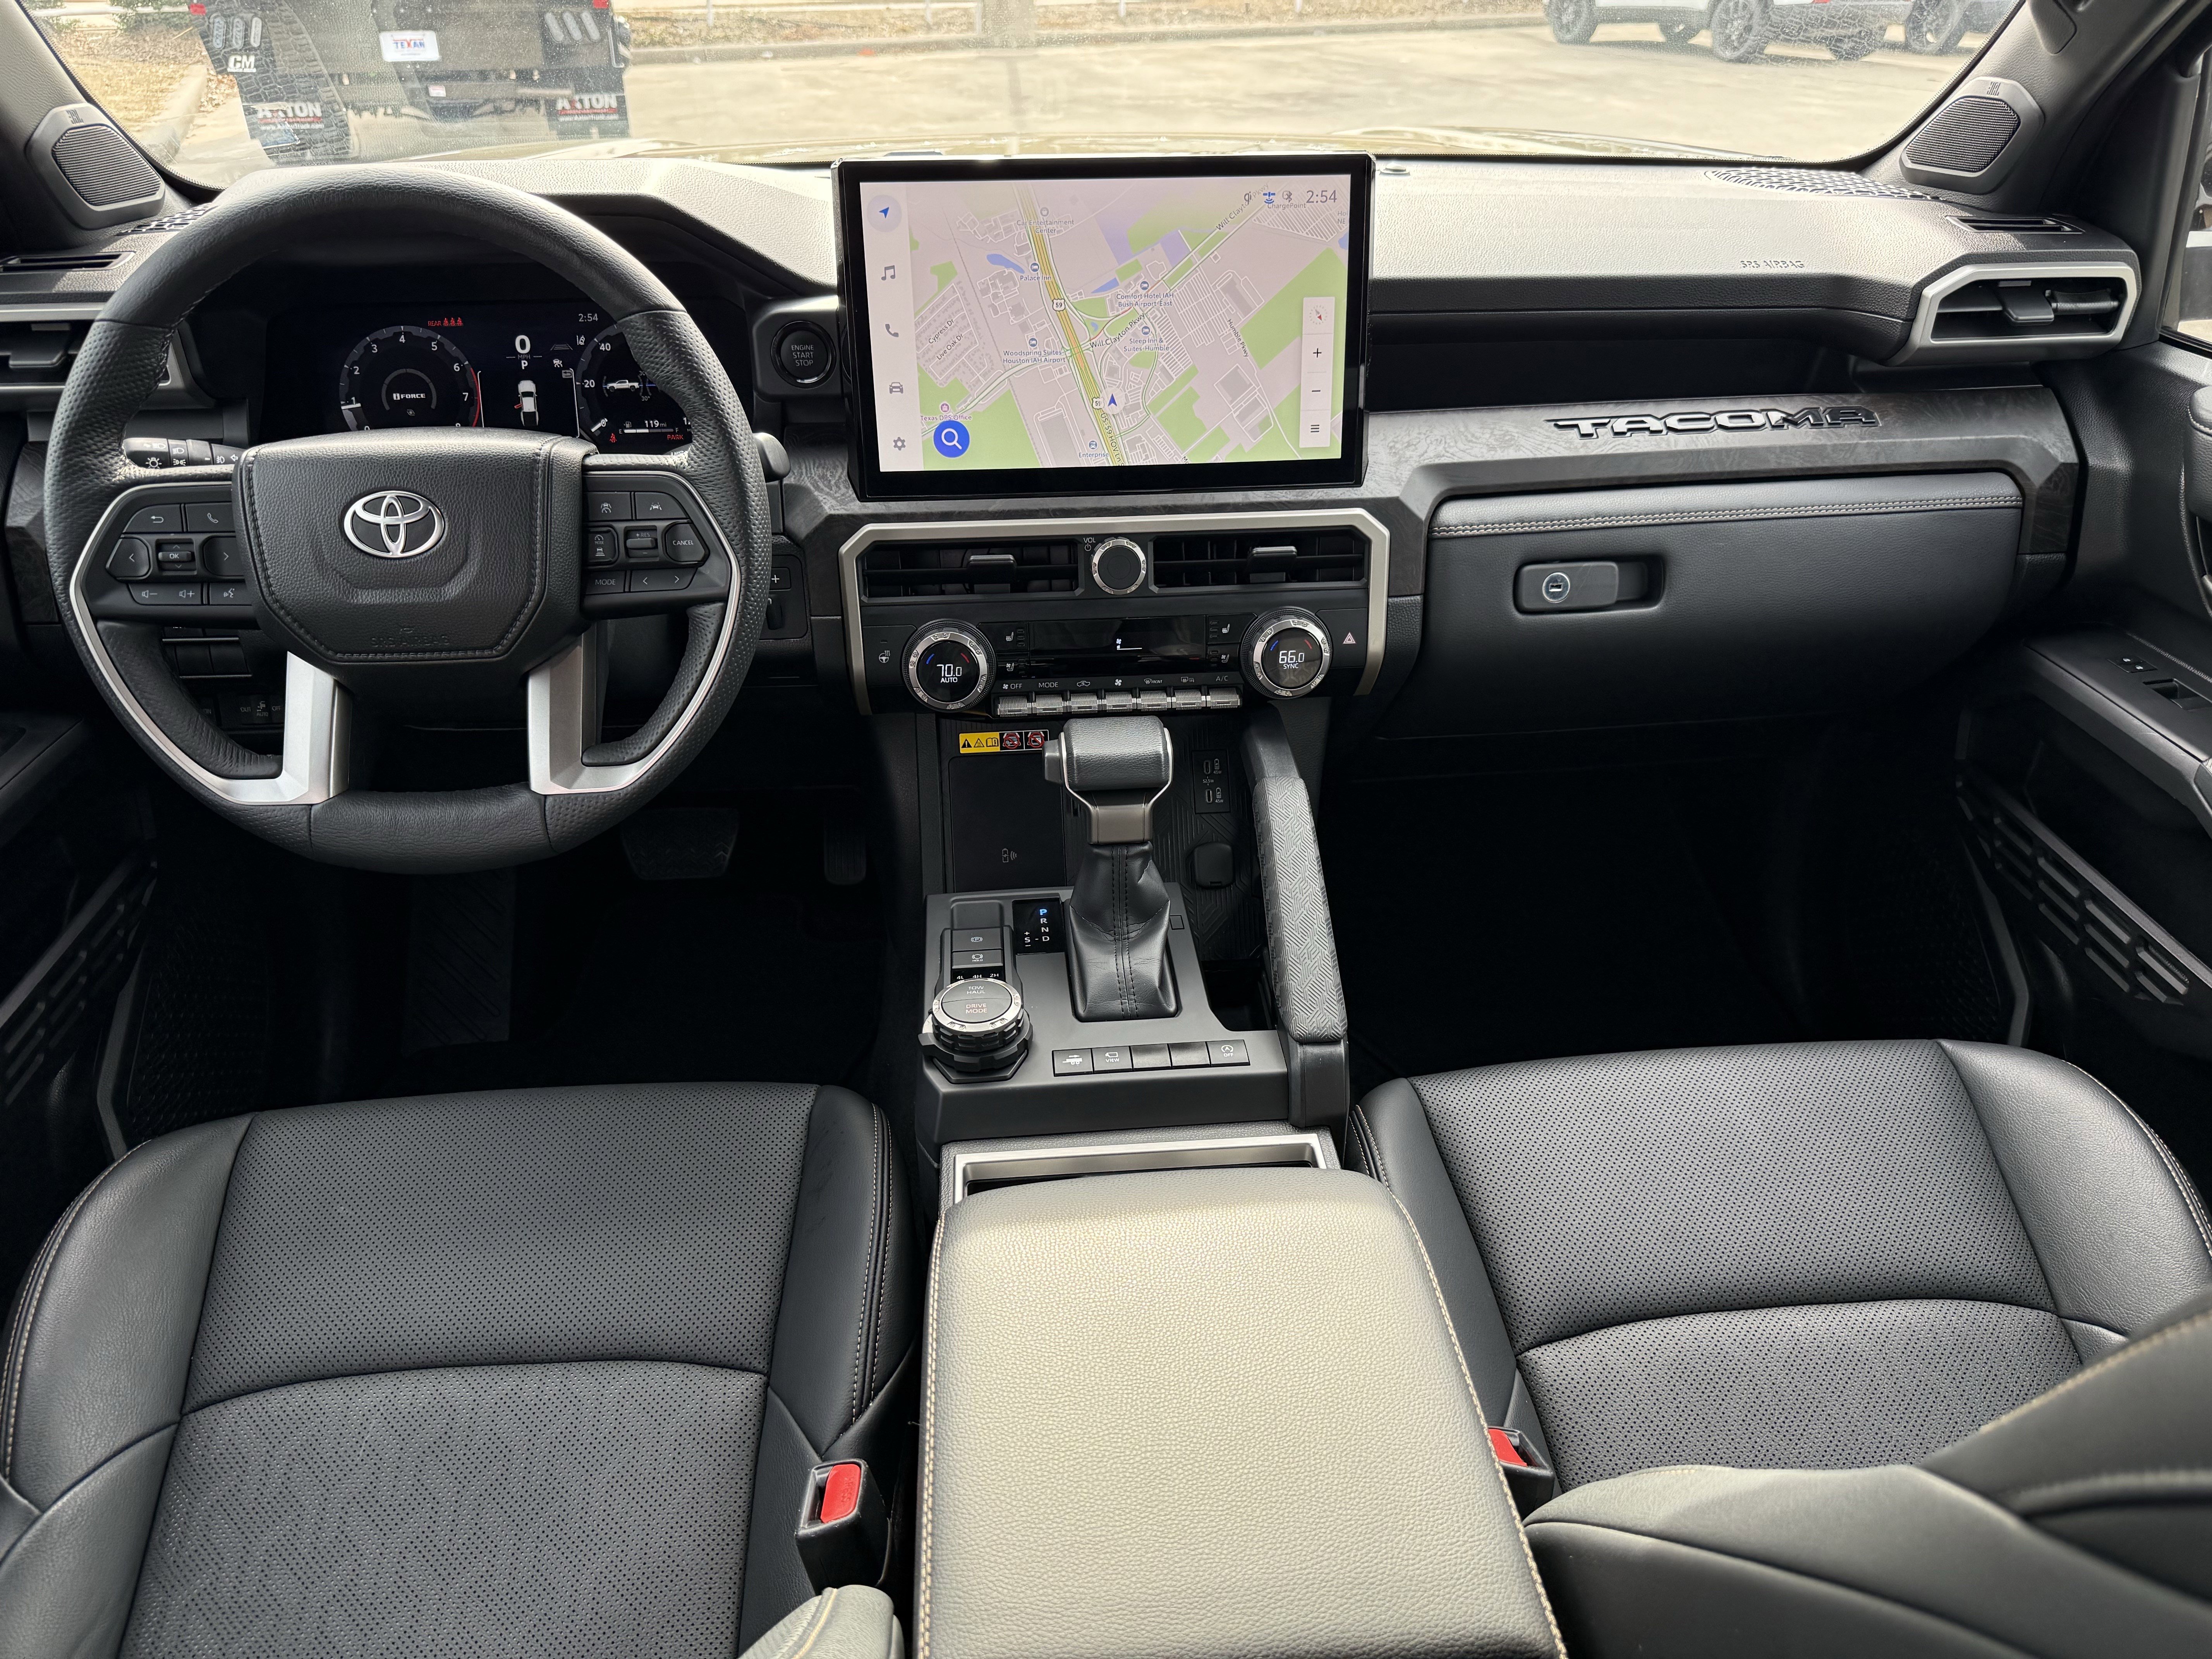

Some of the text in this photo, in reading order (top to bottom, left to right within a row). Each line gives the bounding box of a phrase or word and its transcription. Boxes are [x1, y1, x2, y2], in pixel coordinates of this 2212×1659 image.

[392, 39, 425, 49] TEXAN
[228, 55, 255, 69] CM
[556, 94, 617, 110] AXTON
[1306, 190, 1337, 203] 2:54
[1216, 217, 1230, 230] Will
[1252, 183, 1269, 198] Pkwy
[1763, 260, 1805, 268] AIRBAG
[578, 313, 598, 321] 2:54
[928, 325, 948, 344] Cypress
[1089, 313, 1145, 349] Will Clayton Pkwy
[399, 335, 406, 343] 4
[515, 335, 531, 354] 0
[1227, 319, 1249, 357] Humble Pkwy
[371, 344, 378, 353] 3
[431, 342, 438, 350] 5
[936, 349, 948, 360] Live
[946, 340, 958, 350] Oak
[353, 366, 360, 375] 2
[453, 363, 460, 371] 6
[521, 360, 528, 369] P
[351, 397, 357, 405] 1
[462, 392, 469, 401] 7
[1545, 406, 1881, 440] TACOMA
[1100, 412, 1121, 462] US-59 HOV Ln
[1279, 650, 1305, 663] 66.0
[936, 664, 962, 677] 70.0
